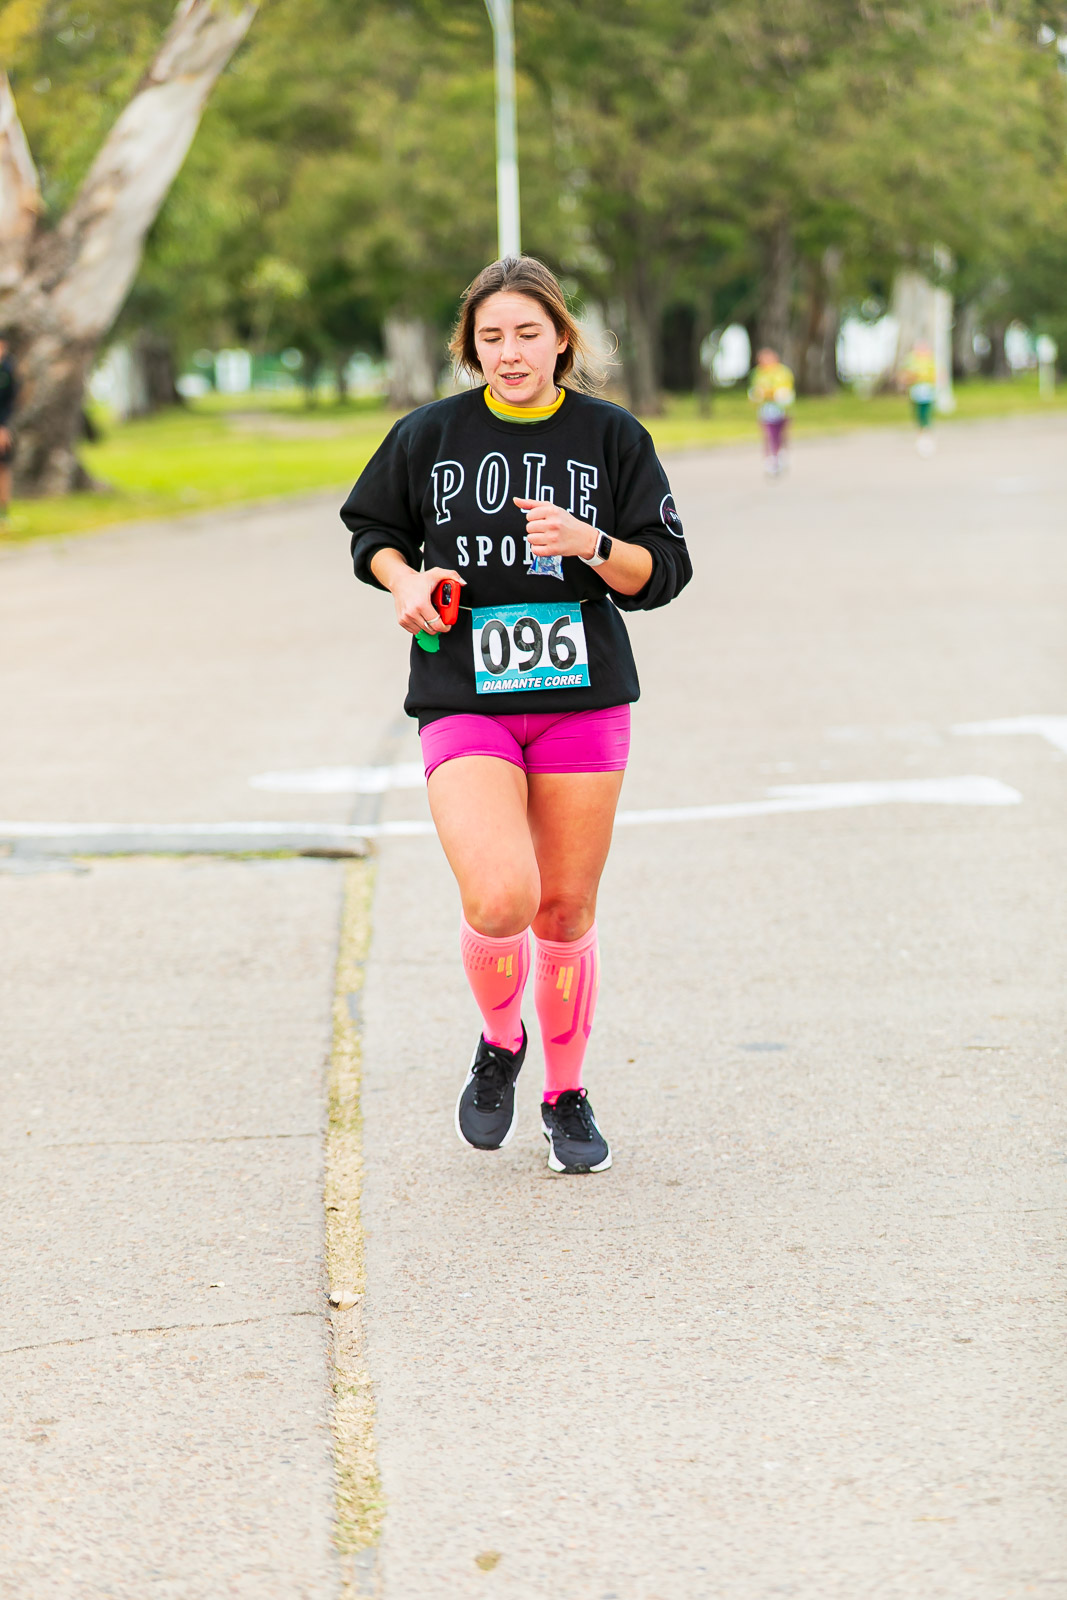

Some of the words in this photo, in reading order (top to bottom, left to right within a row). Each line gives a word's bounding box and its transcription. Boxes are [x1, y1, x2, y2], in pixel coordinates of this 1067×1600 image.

[431, 452, 598, 528] POLE
[480, 615, 577, 676] 096
[482, 677, 542, 691] DIAMANTE
[544, 674, 583, 687] CORRE
